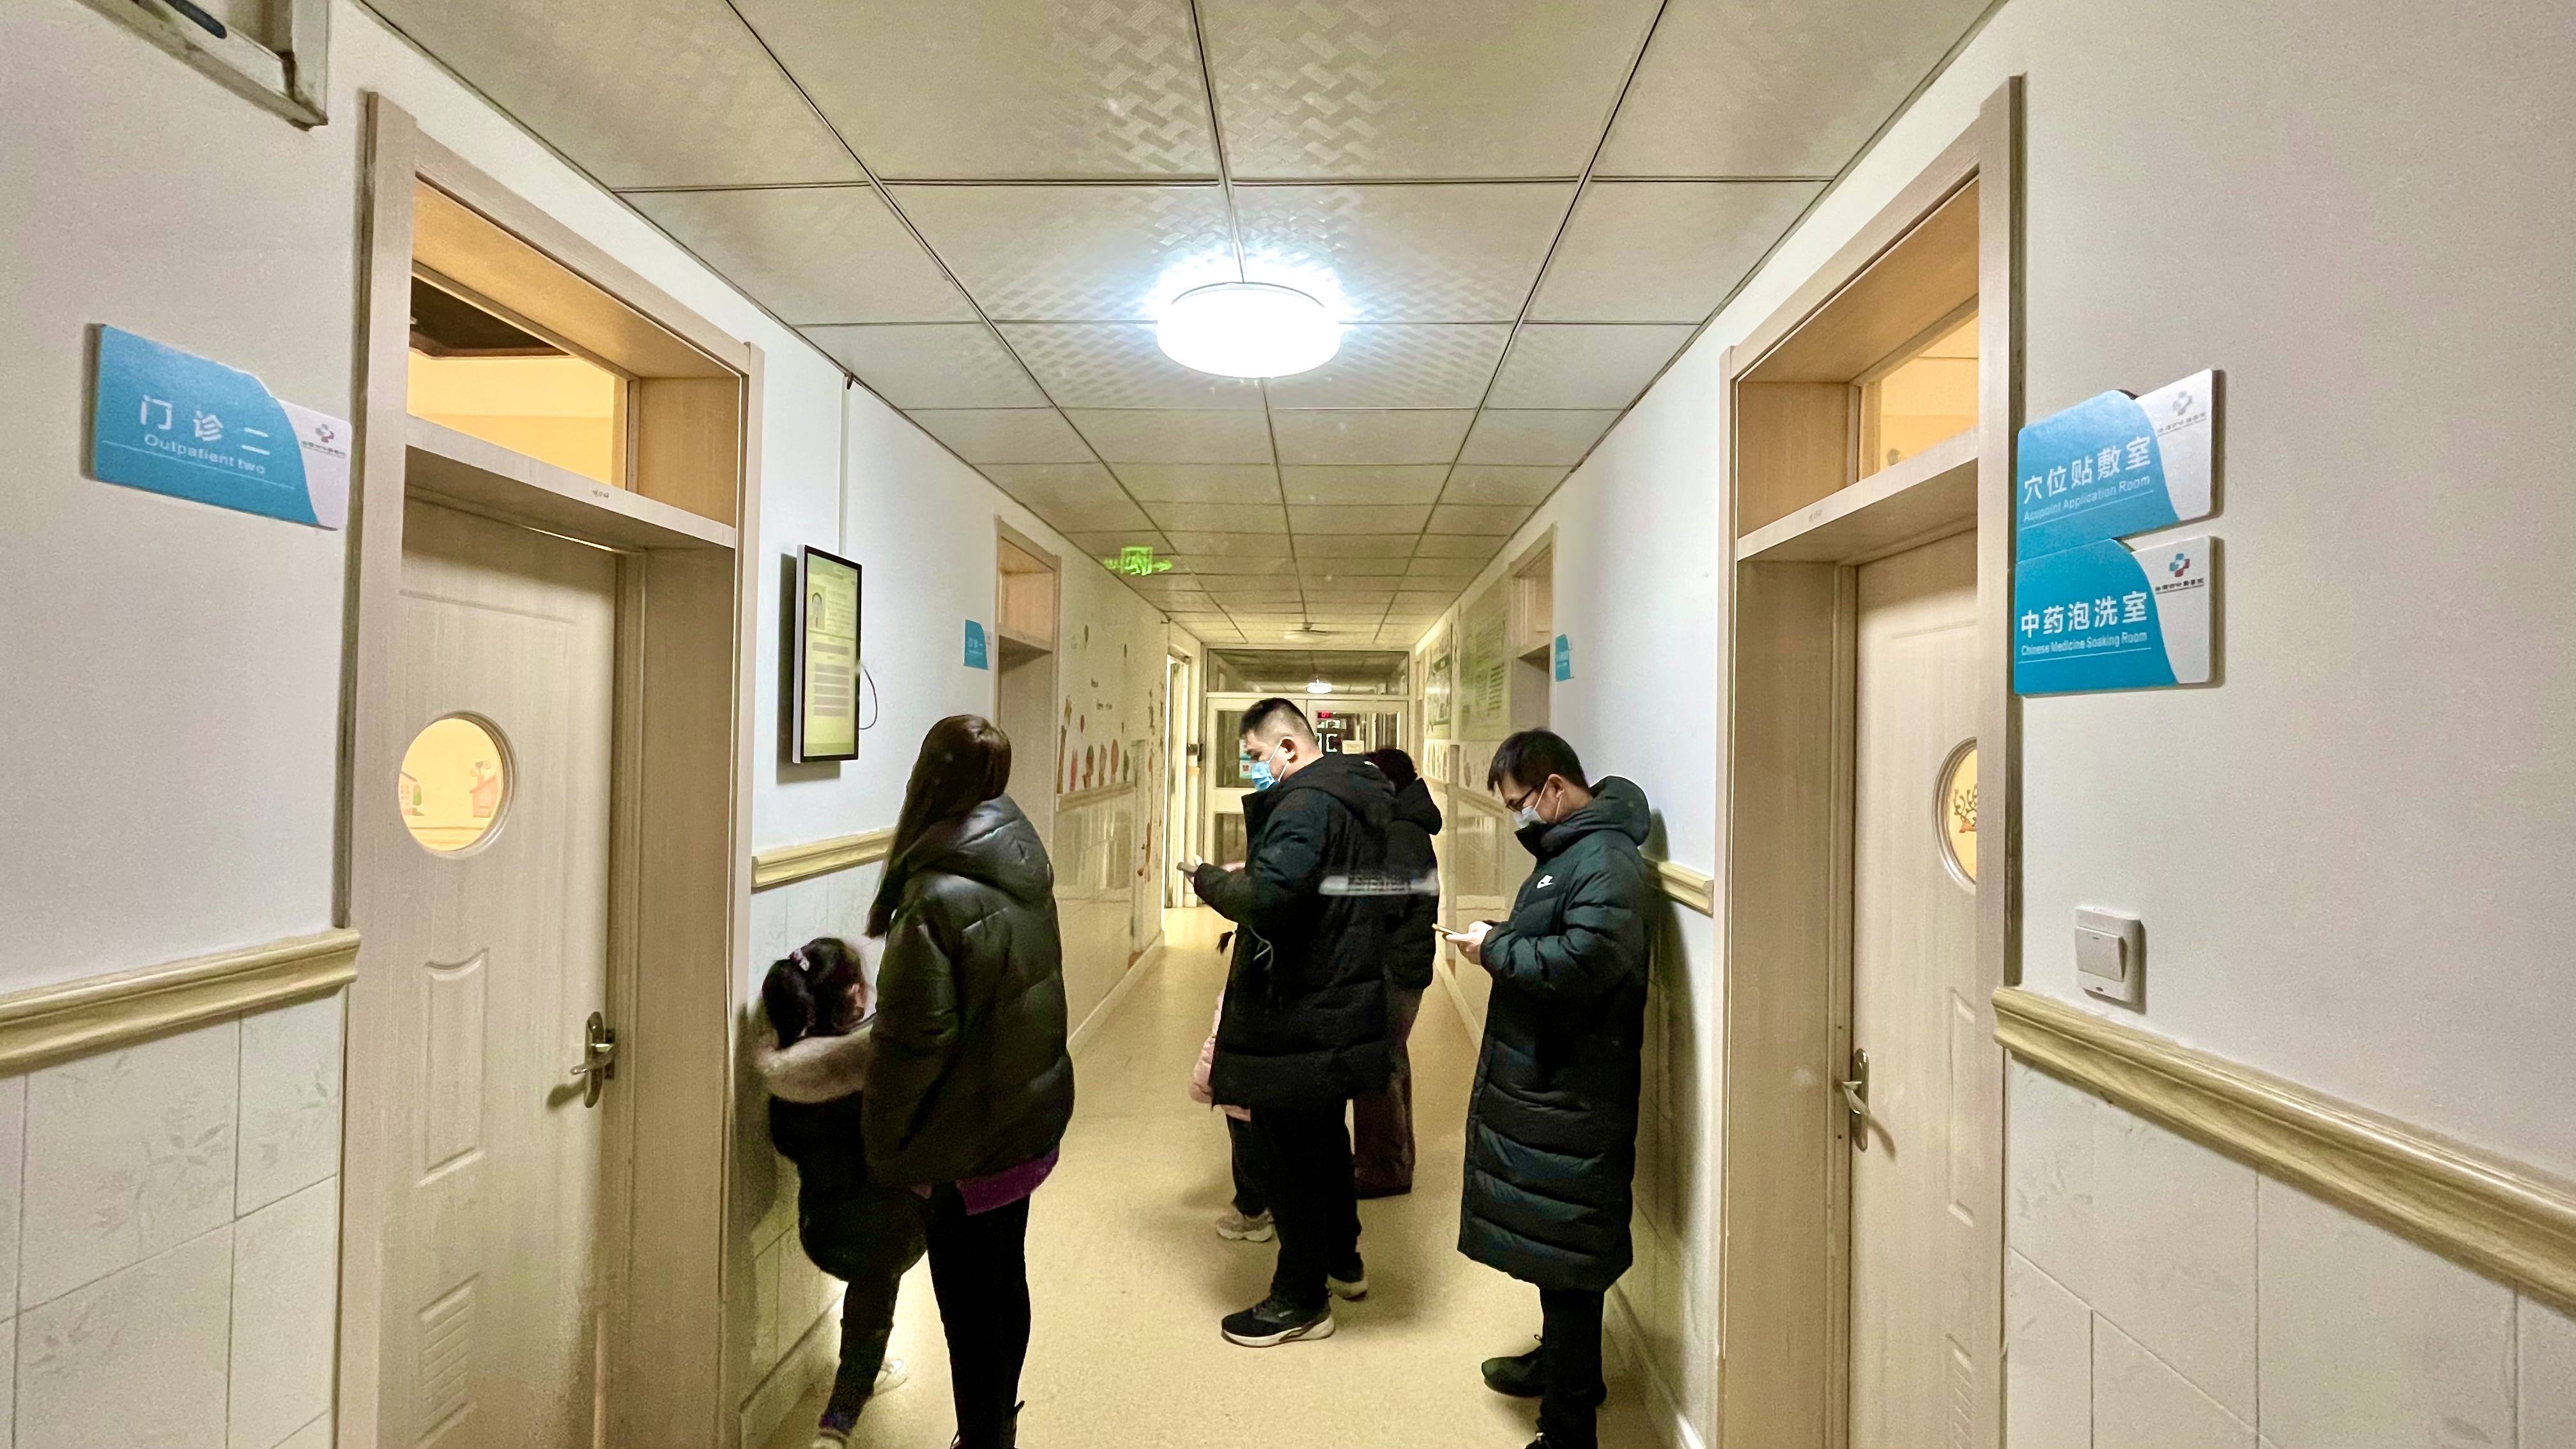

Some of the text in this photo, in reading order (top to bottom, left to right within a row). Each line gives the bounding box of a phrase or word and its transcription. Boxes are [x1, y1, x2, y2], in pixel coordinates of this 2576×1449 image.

[140, 394, 270, 456] 门诊二
[144, 434, 265, 474] Outpatient two
[2023, 436, 2151, 504] 穴位贴敷室
[2023, 475, 2150, 523] Acupoint Application Room
[2021, 590, 2147, 638] 中药泡洗室
[2021, 631, 2147, 656] Chinese Medicine Soaking Room
